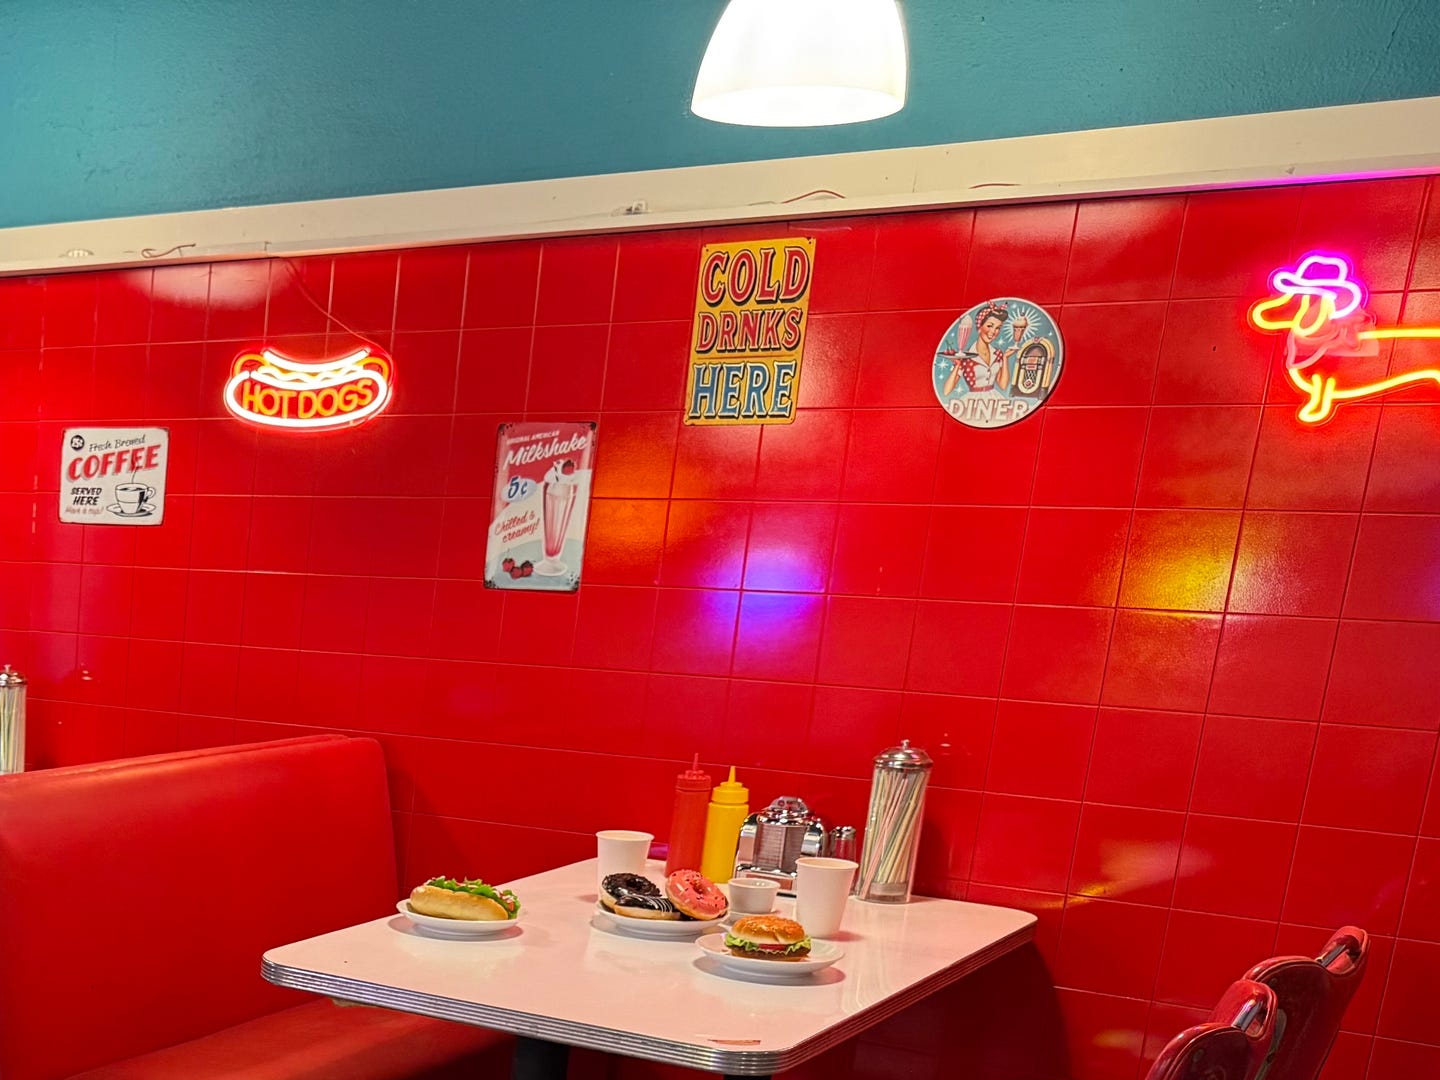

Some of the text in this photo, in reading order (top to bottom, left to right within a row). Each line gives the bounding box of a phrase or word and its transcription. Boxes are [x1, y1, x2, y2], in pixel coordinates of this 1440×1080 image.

[701, 246, 810, 306] COLD
[696, 308, 803, 353] DRNKS
[242, 378, 374, 420] HOT DOGS
[689, 361, 798, 419] HERE
[948, 398, 1029, 422] DINER
[114, 434, 146, 449] Brewed
[502, 432, 588, 471] Milkshake
[67, 445, 162, 482] COFFEE
[71, 487, 102, 495] SERVED
[507, 476, 528, 498] 5¢
[73, 496, 100, 506] HERE
[495, 510, 528, 535] Chilled
[502, 517, 540, 543] creamy!
